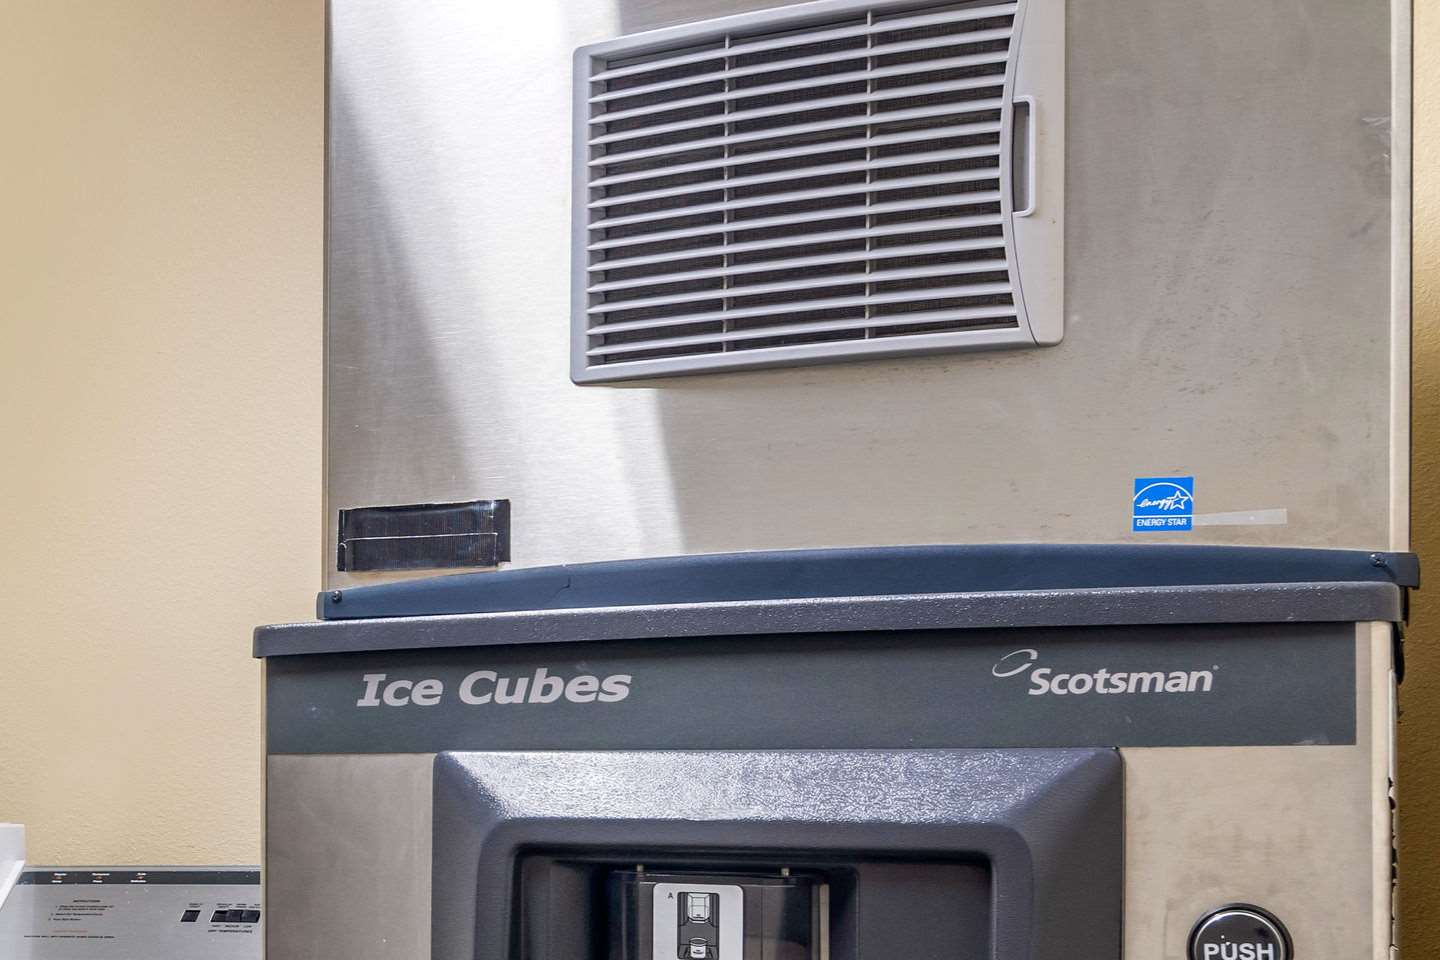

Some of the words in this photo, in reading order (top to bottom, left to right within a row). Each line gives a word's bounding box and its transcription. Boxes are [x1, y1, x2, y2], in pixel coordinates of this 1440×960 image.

[1136, 518, 1166, 527] ENERGY
[1167, 518, 1187, 526] STAR
[356, 673, 443, 707] Ice
[459, 668, 632, 705] Cubes
[1028, 667, 1213, 695] Scotsman
